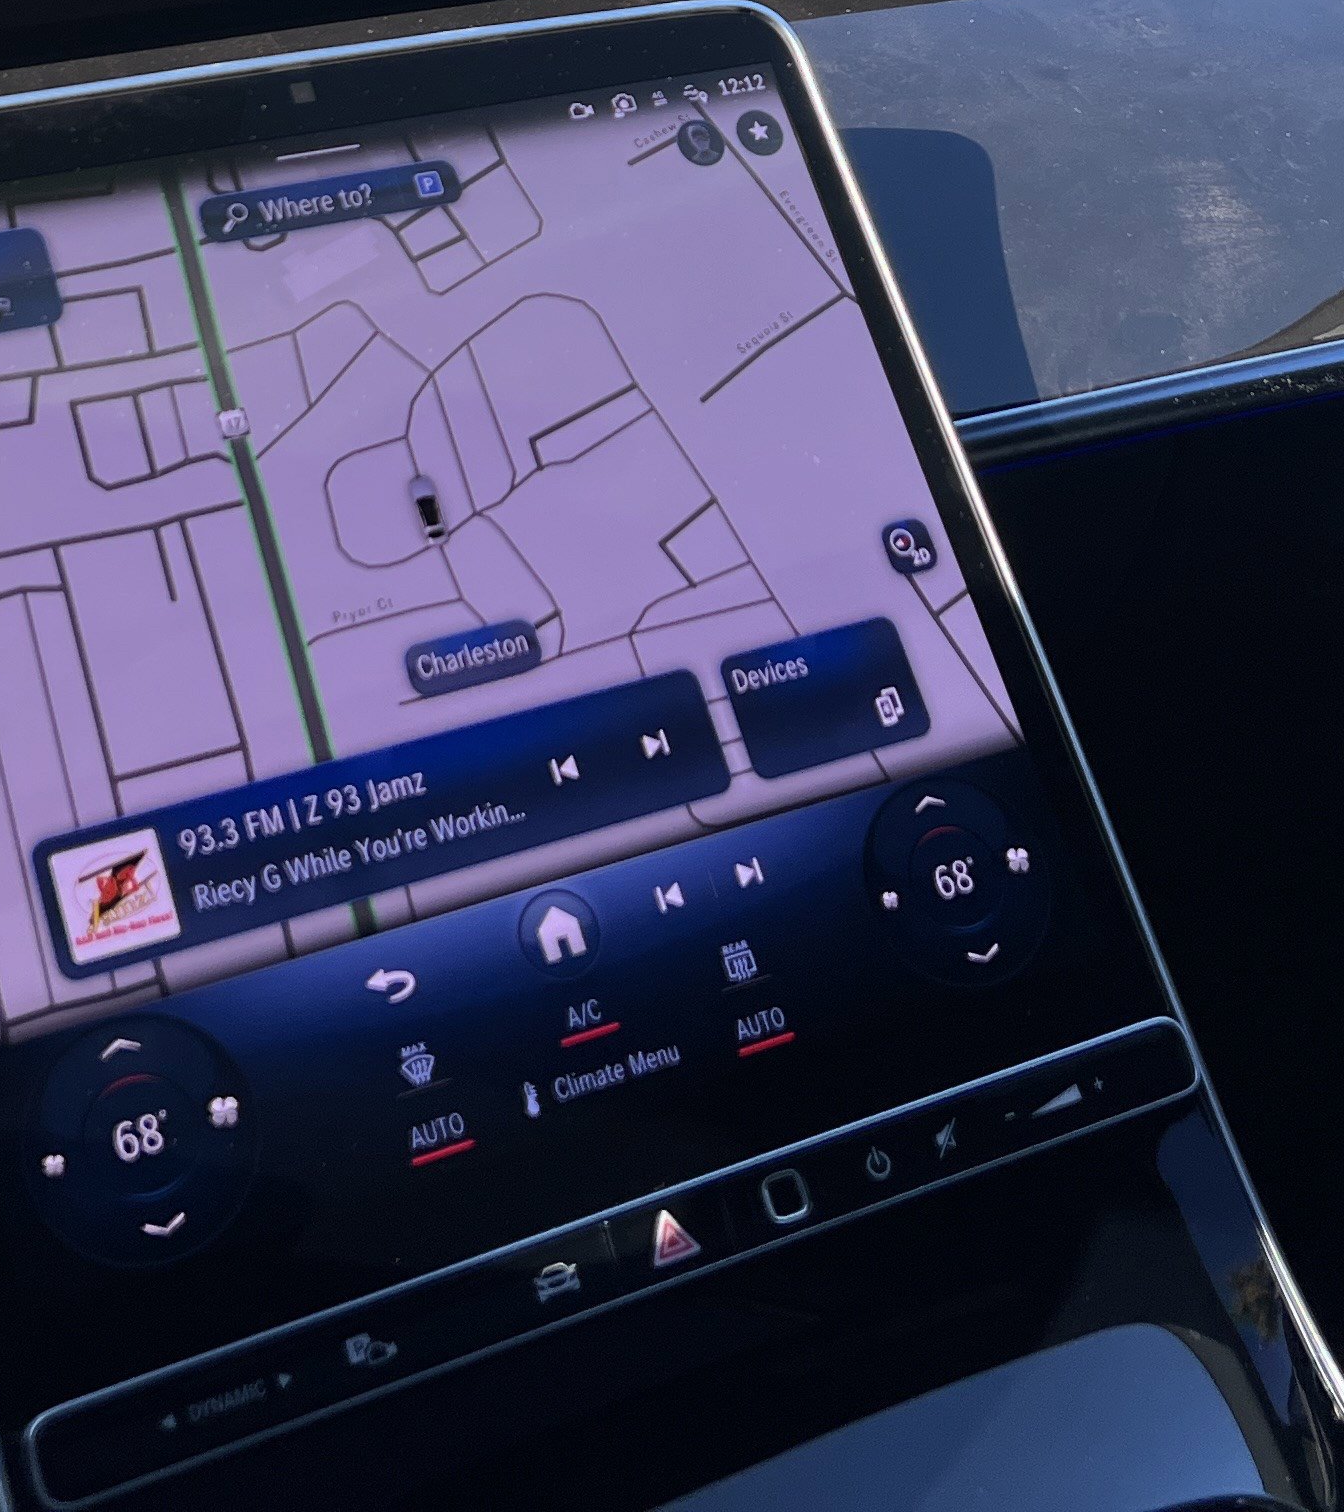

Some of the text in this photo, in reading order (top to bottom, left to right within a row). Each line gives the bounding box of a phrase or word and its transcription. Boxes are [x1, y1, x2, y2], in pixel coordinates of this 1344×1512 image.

[718, 74, 766, 96] 12:12
[258, 183, 373, 223] Where to?
[416, 634, 530, 681] Charleston
[731, 657, 809, 694] Devices
[178, 817, 240, 860] 93.3
[243, 804, 286, 841] FM
[303, 794, 323, 826] Z
[326, 784, 361, 818] 93
[366, 771, 427, 813] Jamz
[192, 875, 257, 913] Riecy
[261, 863, 282, 893] G
[282, 846, 353, 886] While
[354, 828, 428, 866] You're
[428, 801, 526, 844] Workin...
[568, 998, 602, 1029] A/C
[737, 1007, 785, 1040] AUTO
[555, 1044, 680, 1102] Climate Menu
[411, 1112, 464, 1149] AUTO
